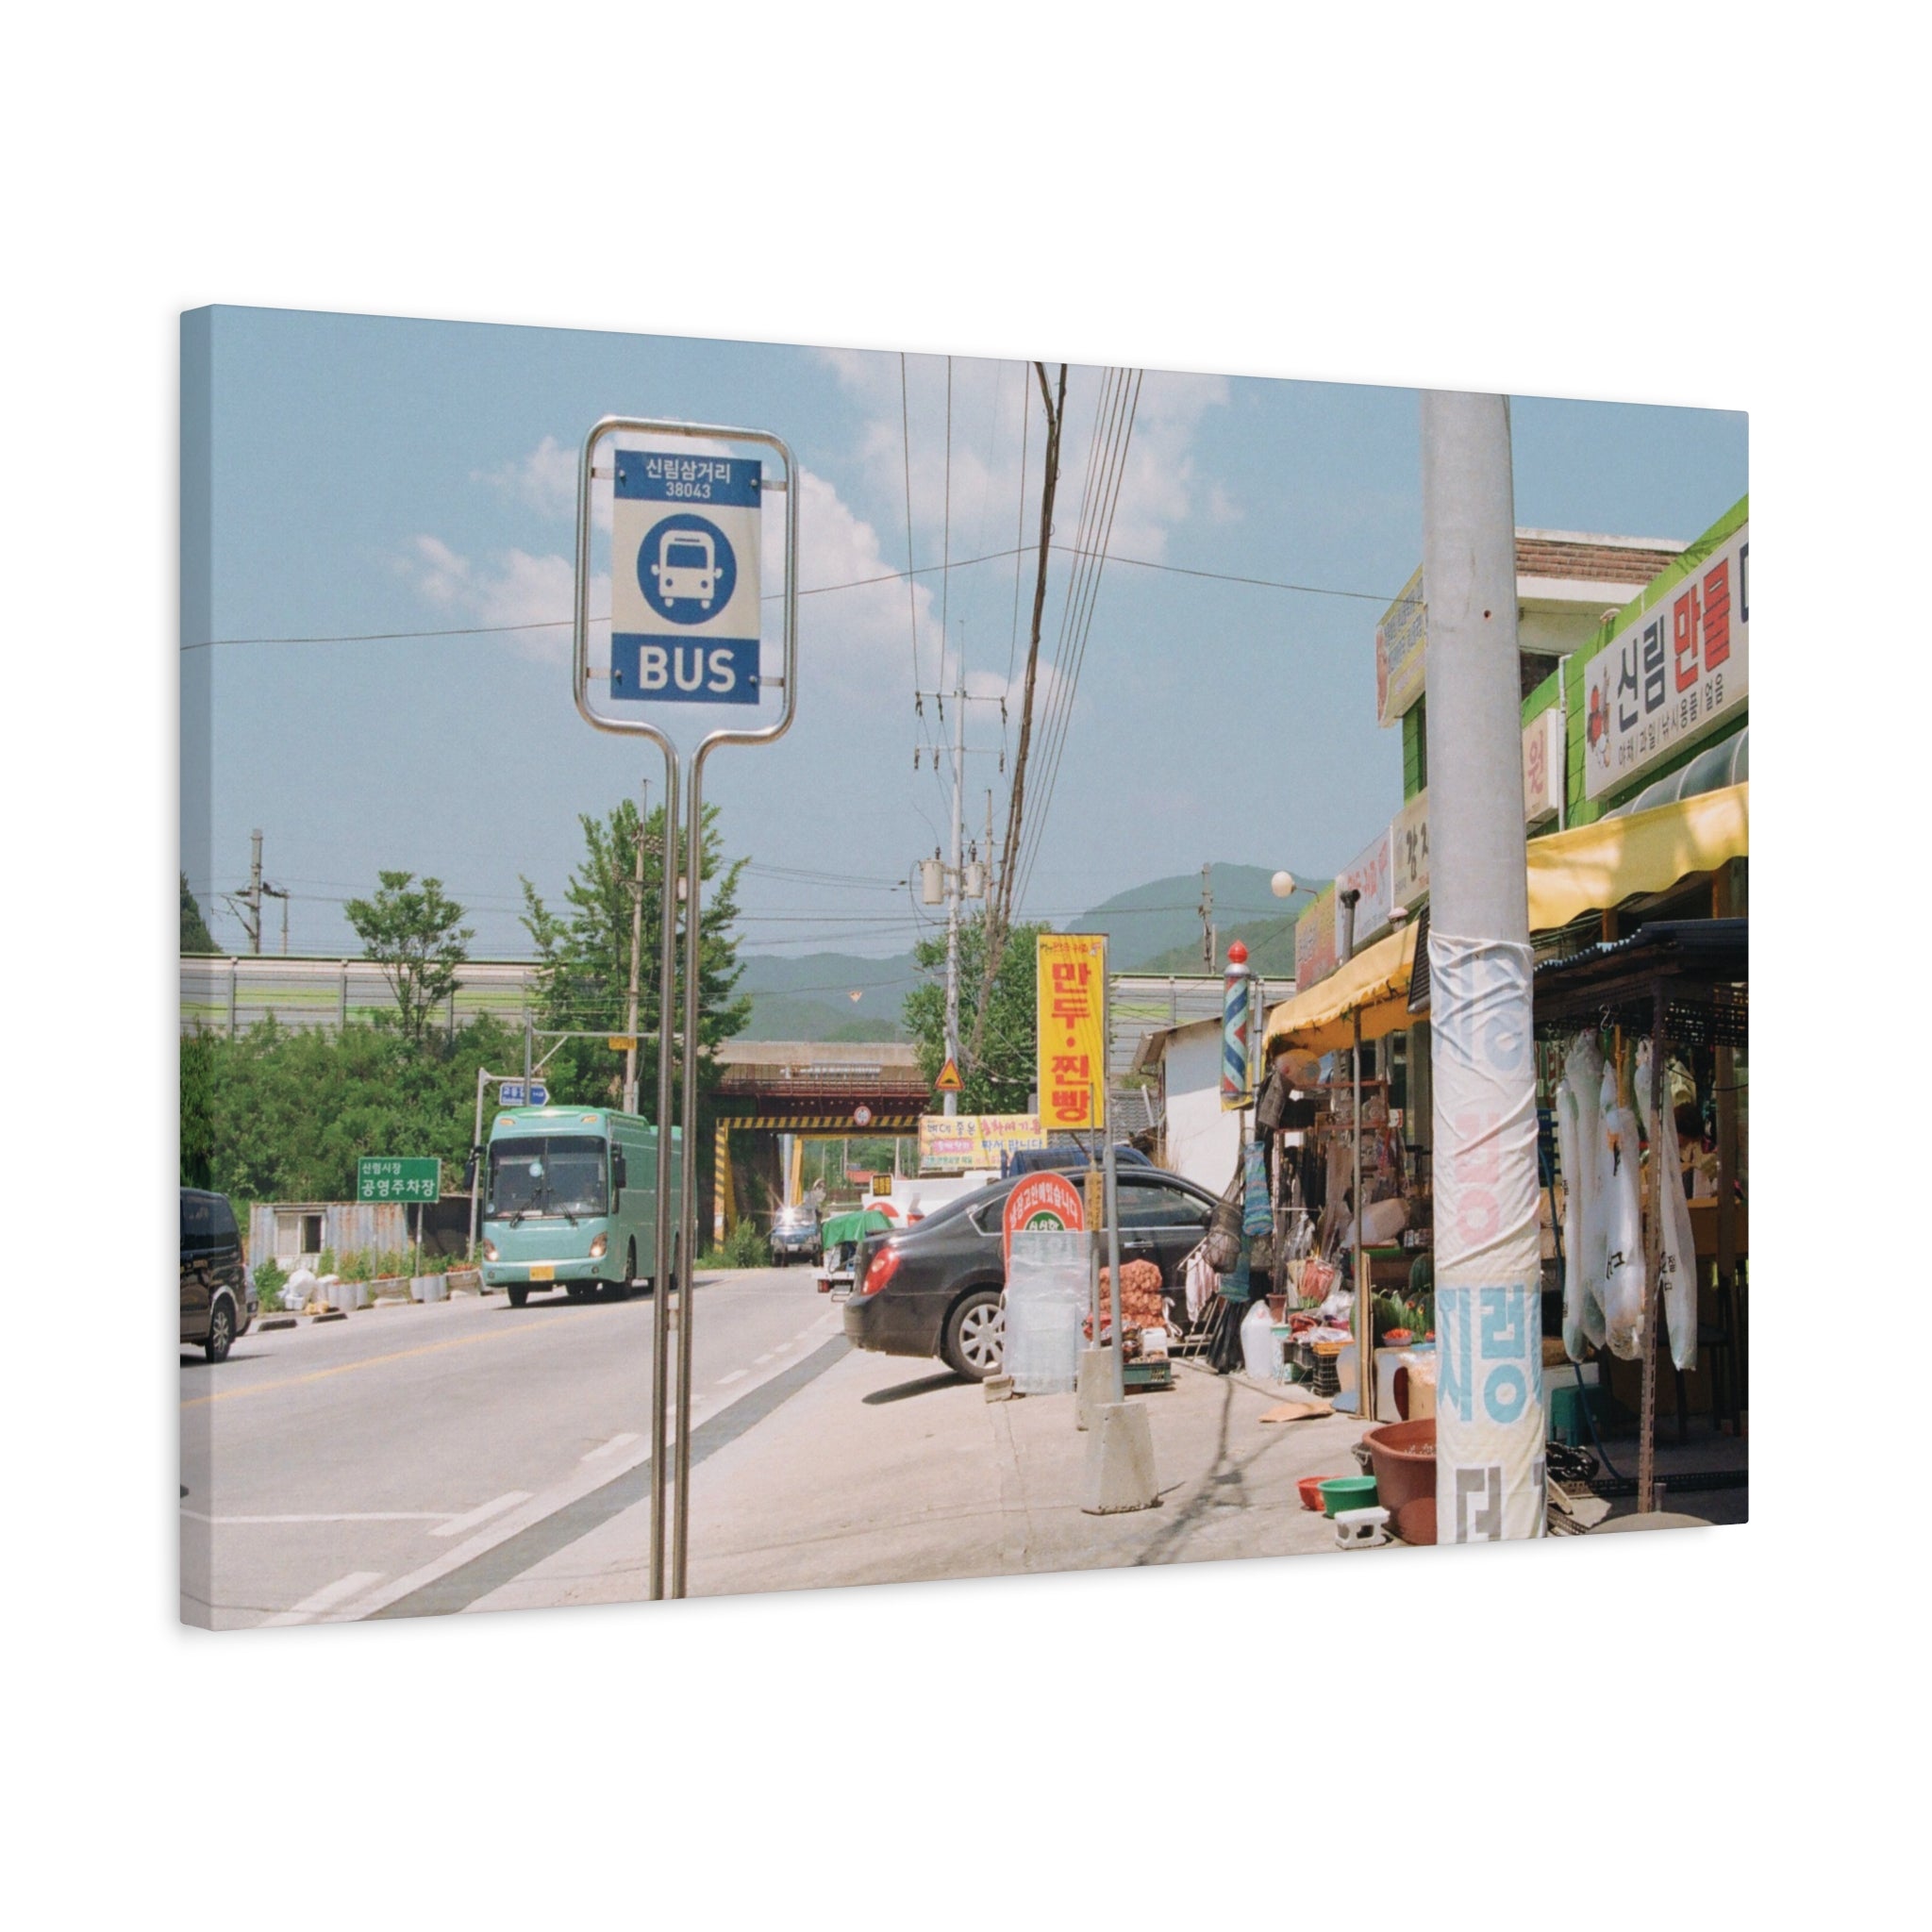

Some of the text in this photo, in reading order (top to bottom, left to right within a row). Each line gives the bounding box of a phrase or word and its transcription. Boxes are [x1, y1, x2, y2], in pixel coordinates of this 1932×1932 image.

[646, 458, 731, 484] 신림삼거리
[666, 482, 711, 499] 38043
[1617, 615, 1665, 733] 신림
[1673, 558, 1731, 693] 만물
[639, 645, 737, 692] BUS
[1640, 724, 1656, 754] 과일
[1705, 673, 1724, 711] 얼음
[1527, 729, 1544, 794] 원
[956, 1121, 976, 1136] 좋은
[362, 1161, 402, 1175] 신림시장
[360, 1178, 435, 1198] 공영주차장
